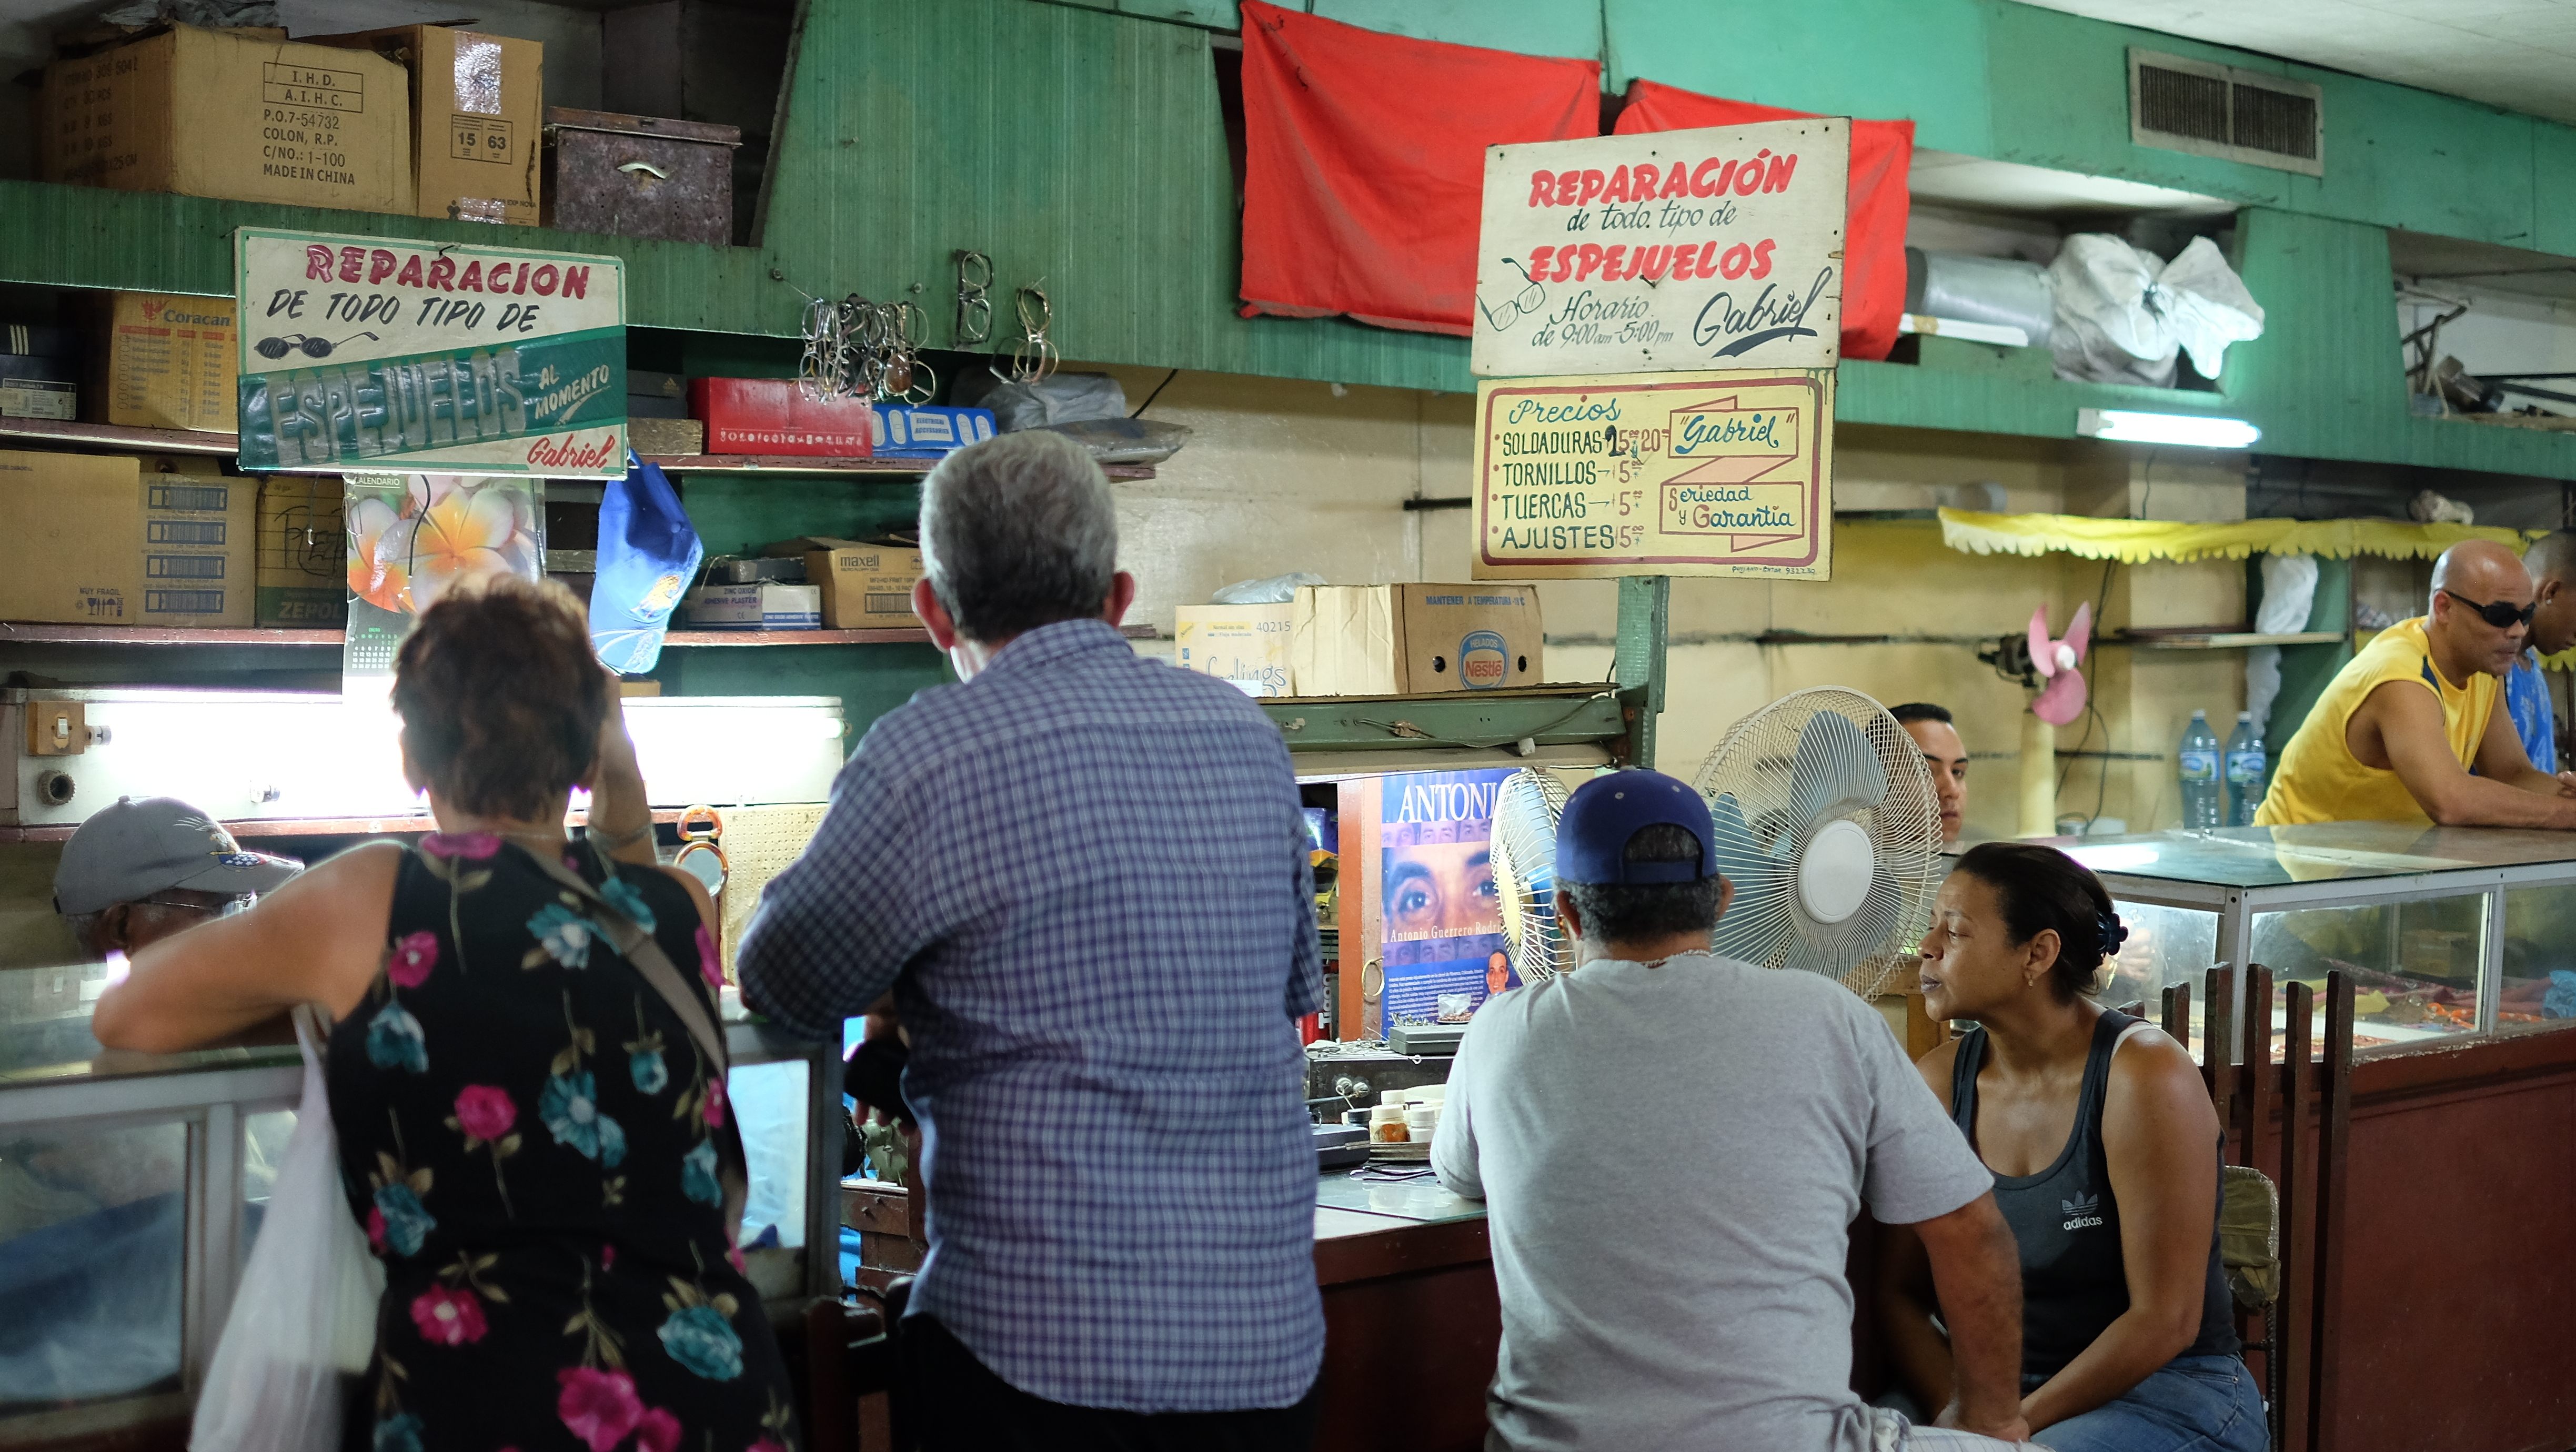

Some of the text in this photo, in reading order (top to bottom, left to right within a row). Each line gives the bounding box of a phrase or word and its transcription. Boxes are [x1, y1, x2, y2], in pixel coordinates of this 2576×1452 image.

[264, 108, 339, 130] P.O.7-54732
[263, 127, 338, 146] COLON, R.P.
[458, 132, 506, 150] 15 63
[309, 150, 346, 168] 1-100
[263, 164, 355, 185] MADE IN CHINA
[1528, 148, 1798, 208] REPARACIÓN
[1567, 207, 1590, 231] de
[1659, 200, 1704, 238] tipo
[1709, 200, 1738, 226] de
[306, 244, 590, 300] REPARACION
[1528, 238, 1777, 284] ESPEJUELOS
[164, 309, 230, 327] Coracan
[266, 289, 540, 332] DE TODO TIPO DE
[1549, 289, 1650, 325] Horario
[1693, 266, 1833, 347] Gabriel
[1532, 322, 1555, 347] de
[538, 364, 560, 390] AL
[534, 364, 609, 420] MOMENTO
[265, 347, 527, 469] ESPEJUELOS
[1509, 394, 1622, 425] Precios
[527, 433, 616, 468] Gabriel
[1503, 429, 1603, 457] SOLDADURAS
[1503, 460, 1597, 487] TORNILLOS
[1502, 492, 1586, 521] TUERCAS
[1668, 485, 1754, 512] Seriedad
[1678, 509, 1686, 525] y
[1501, 525, 1615, 550] AJUSTES
[840, 554, 879, 567] maxell
[278, 601, 343, 619] ZEPOL
[1426, 596, 1464, 606] MANTENER
[1256, 621, 1291, 632] 40215
[1470, 638, 1498, 648] HELADOS
[1465, 659, 1503, 678] Nestlé
[1396, 782, 1498, 824] ANTONI
[1390, 921, 1502, 943] Antonio Guerrero Rodri
[2063, 1214, 2103, 1231] adidas
